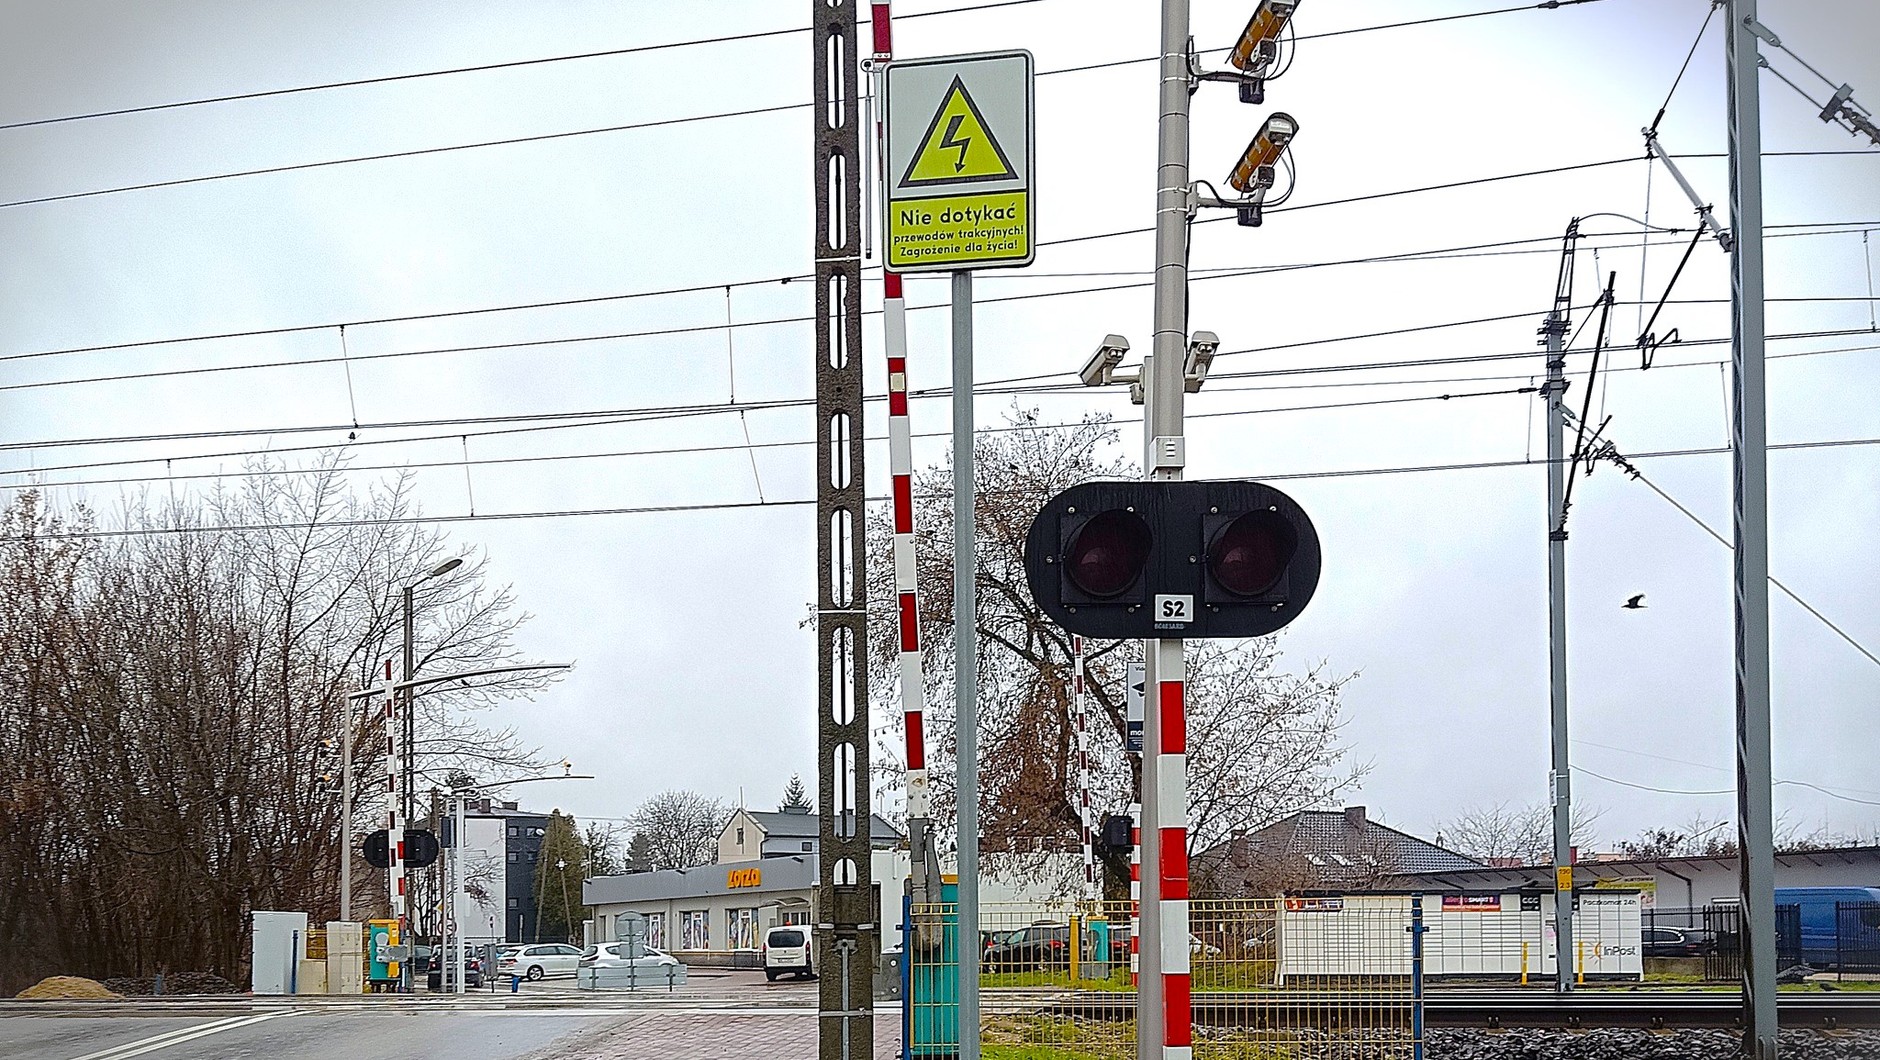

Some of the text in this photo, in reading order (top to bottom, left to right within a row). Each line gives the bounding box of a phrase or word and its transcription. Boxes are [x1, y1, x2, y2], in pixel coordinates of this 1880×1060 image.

[901, 202, 1016, 226] Nie dotykać
[894, 225, 1024, 245] przewodów trakcyjnych!
[900, 240, 1018, 258] Zagrożenie dla życia!
[1162, 600, 1185, 617] S2
[1522, 896, 1539, 904] CCC
[1604, 945, 1636, 956] InPost
